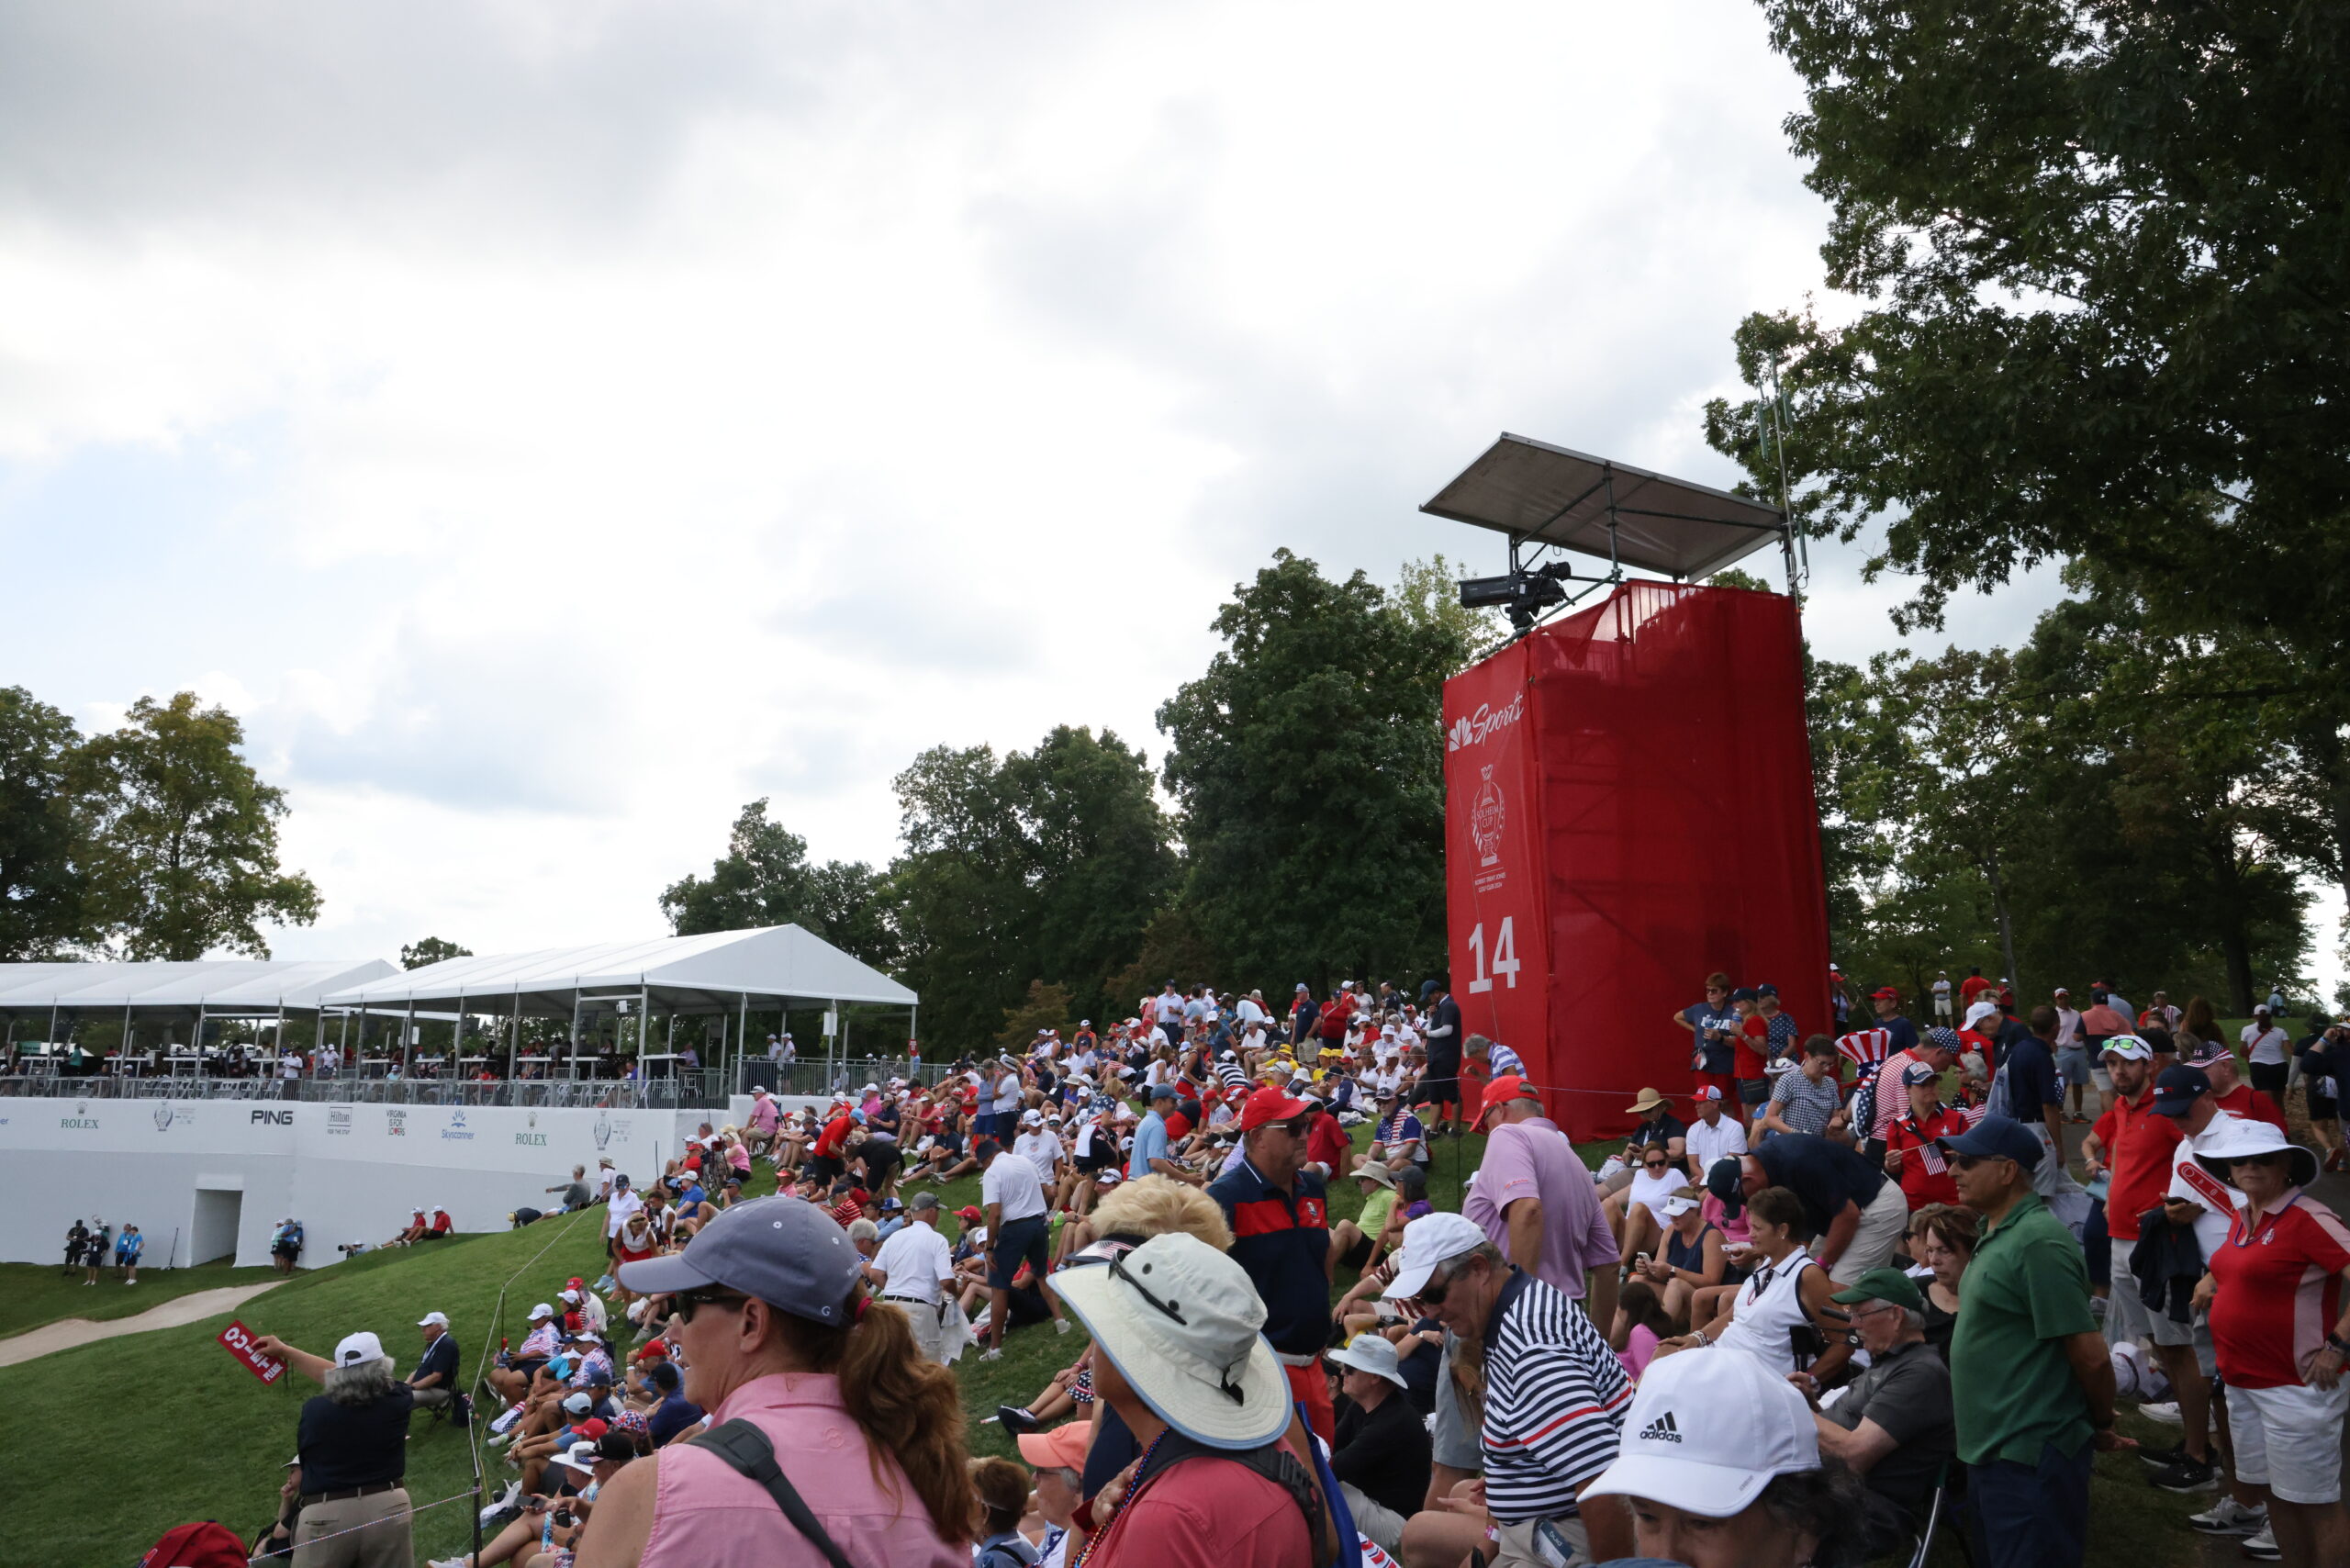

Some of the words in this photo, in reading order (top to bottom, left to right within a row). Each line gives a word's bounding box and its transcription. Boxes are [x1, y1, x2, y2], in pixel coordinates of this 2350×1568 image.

[1472, 690, 1524, 746] Sports
[1476, 805, 1499, 818] SOLHEIM
[1483, 816, 1494, 828] CUP
[1469, 916, 1520, 994] 14
[251, 1110, 294, 1126] PING
[330, 1110, 350, 1123] Hilton
[386, 1109, 407, 1119] VIRGINIA
[61, 1118, 99, 1129] ROLEX
[394, 1118, 403, 1127] FOR
[442, 1129, 475, 1141] Skyscanner
[515, 1133, 547, 1146] ROLEX
[1639, 1428, 1682, 1444] adidas
